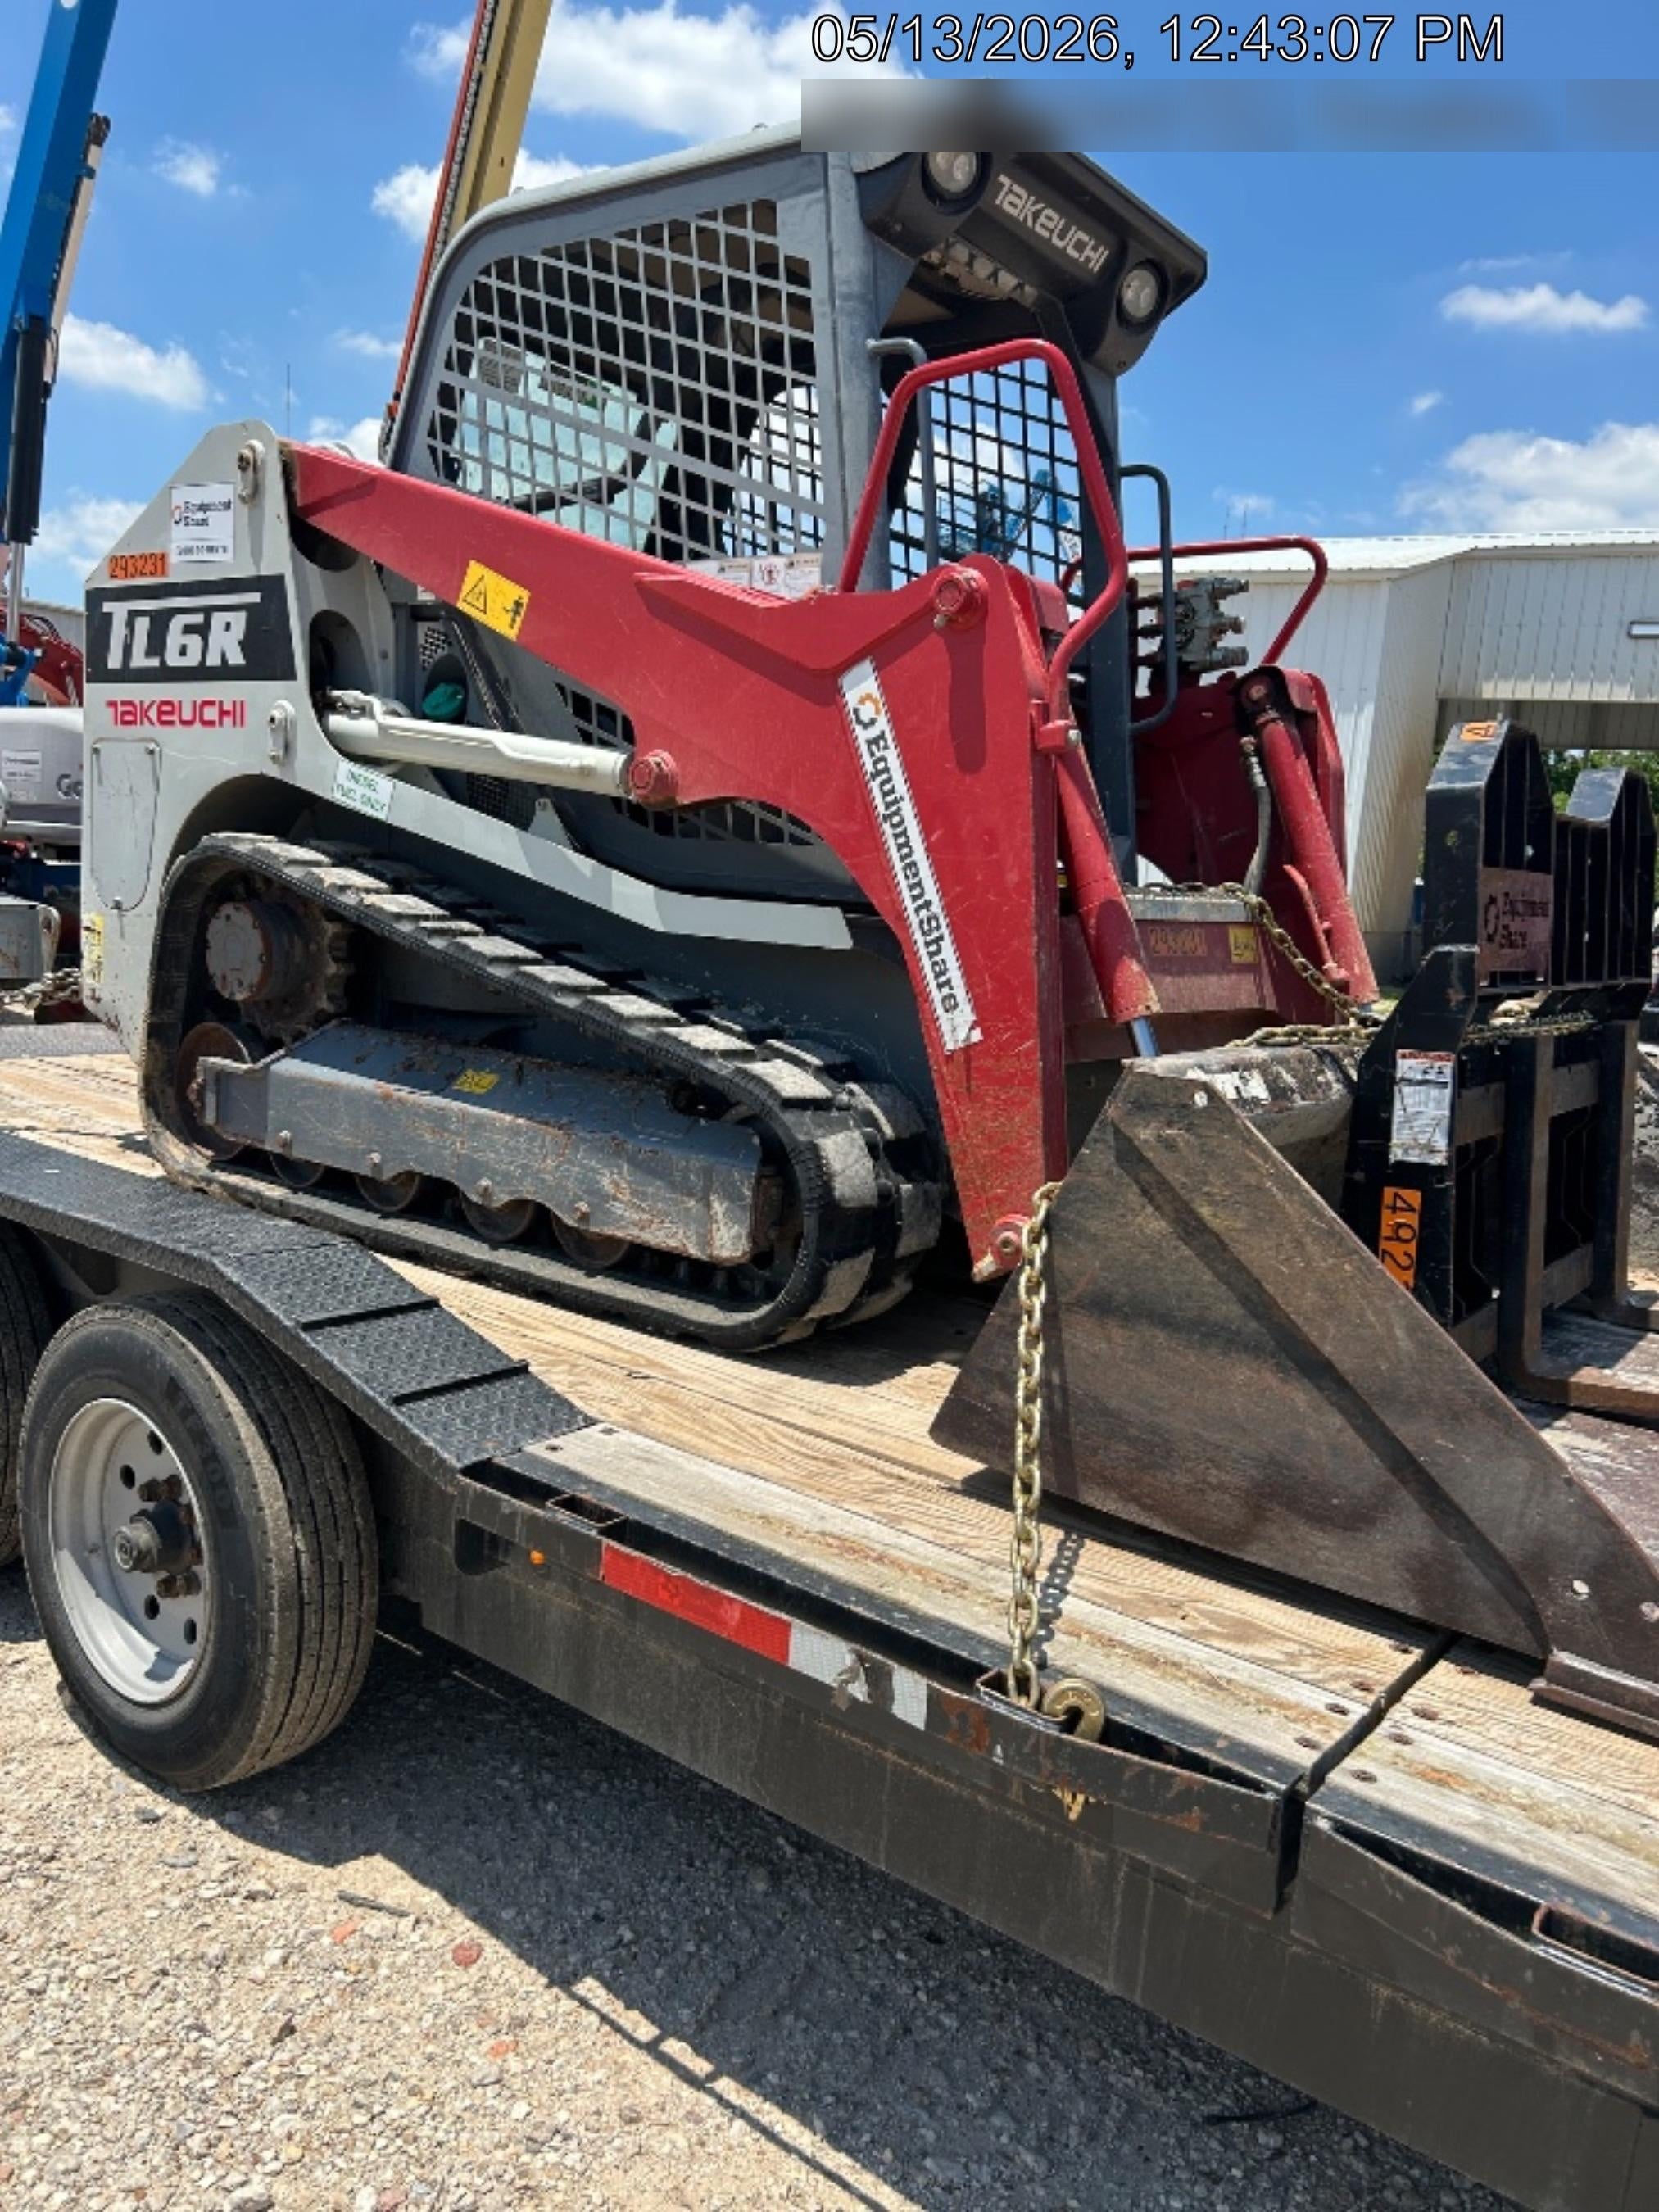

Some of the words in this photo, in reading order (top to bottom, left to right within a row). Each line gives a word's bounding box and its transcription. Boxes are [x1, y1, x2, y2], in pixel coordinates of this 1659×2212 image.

[109, 553, 165, 578] 293231
[102, 592, 261, 669] TL6R
[865, 729, 959, 1013] EquipmentShare
[1381, 1191, 1416, 1290] 492
